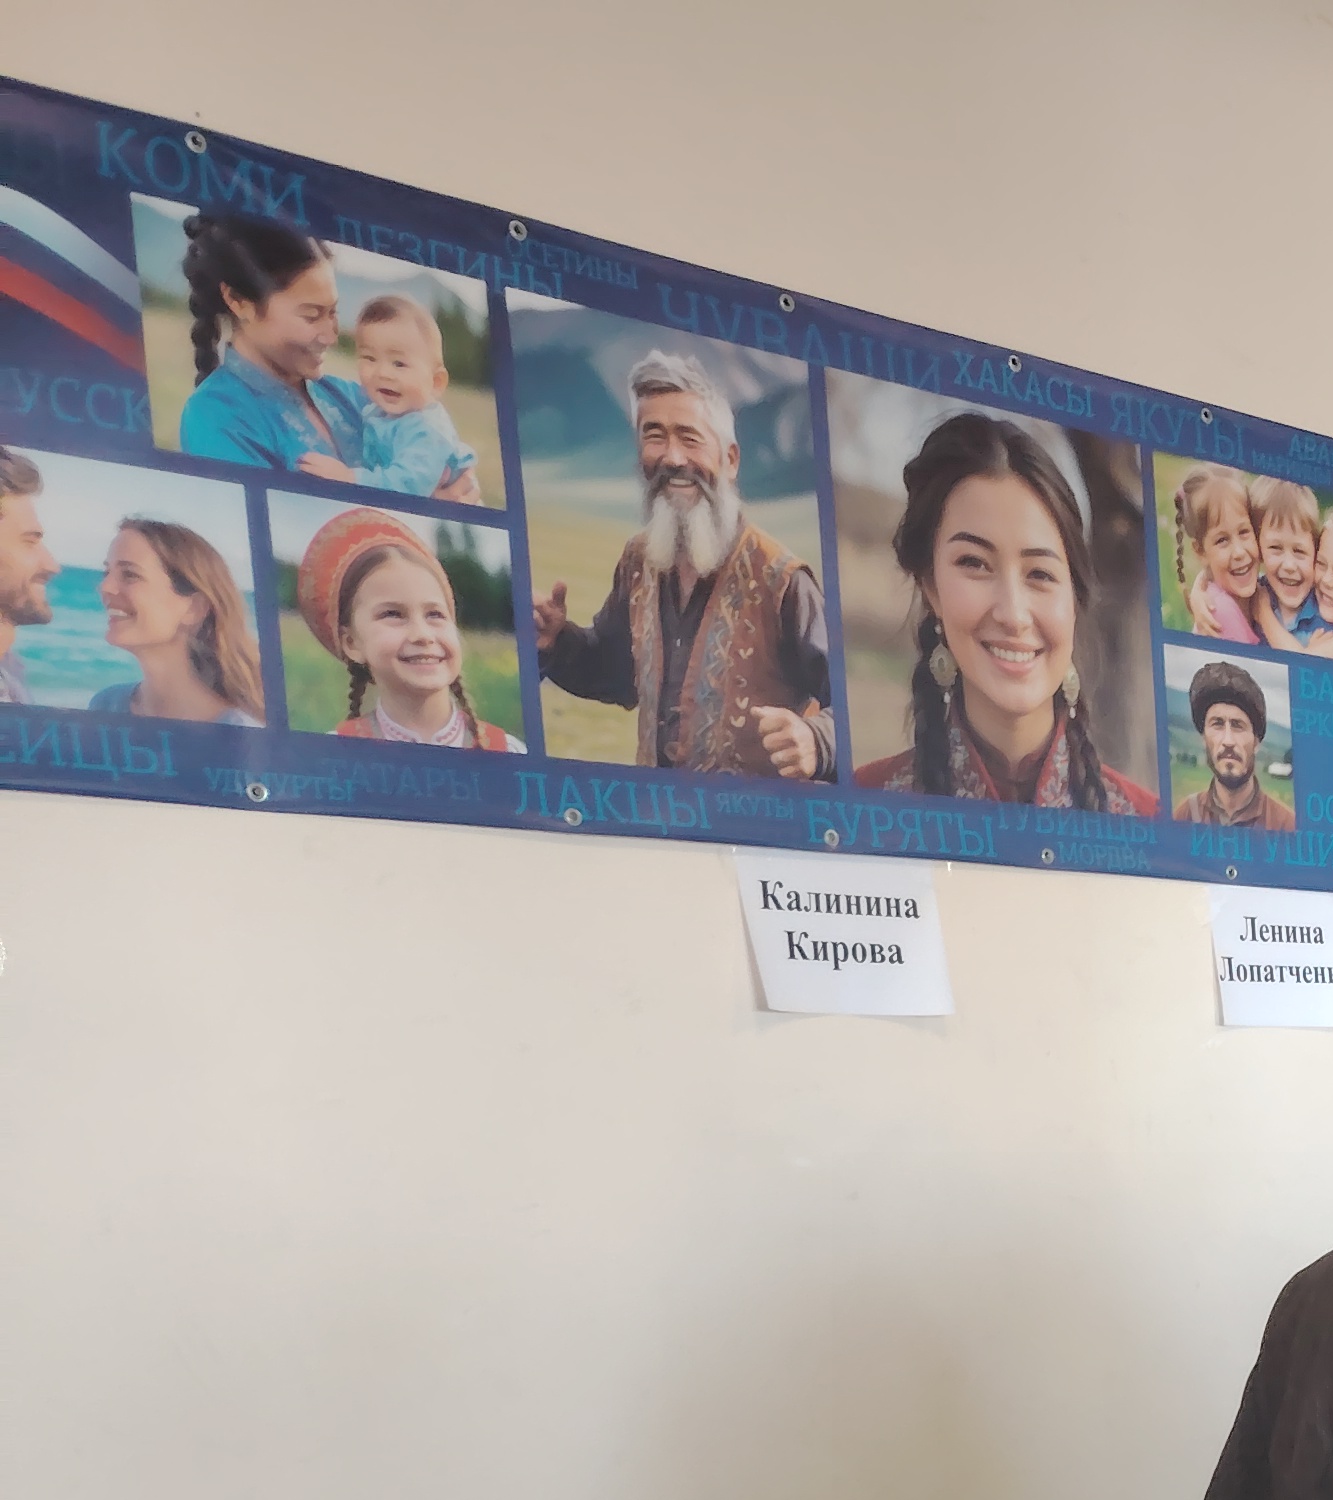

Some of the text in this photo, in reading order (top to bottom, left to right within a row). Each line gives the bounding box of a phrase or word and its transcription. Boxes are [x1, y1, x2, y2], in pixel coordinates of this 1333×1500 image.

[95, 120, 311, 229] КОМИ
[952, 350, 1096, 418] ХАКАСЫ
[1110, 391, 1245, 464] ЯКУТЫ
[514, 770, 712, 836] ЛАКЦЫ
[715, 791, 794, 820] ЯКУТЫ
[805, 798, 998, 859] БУРЯТЫ
[1057, 840, 1151, 872] МОРДВА
[758, 879, 921, 919] Калинина
[784, 930, 905, 971] Кирова
[1239, 916, 1325, 945] Ленина
